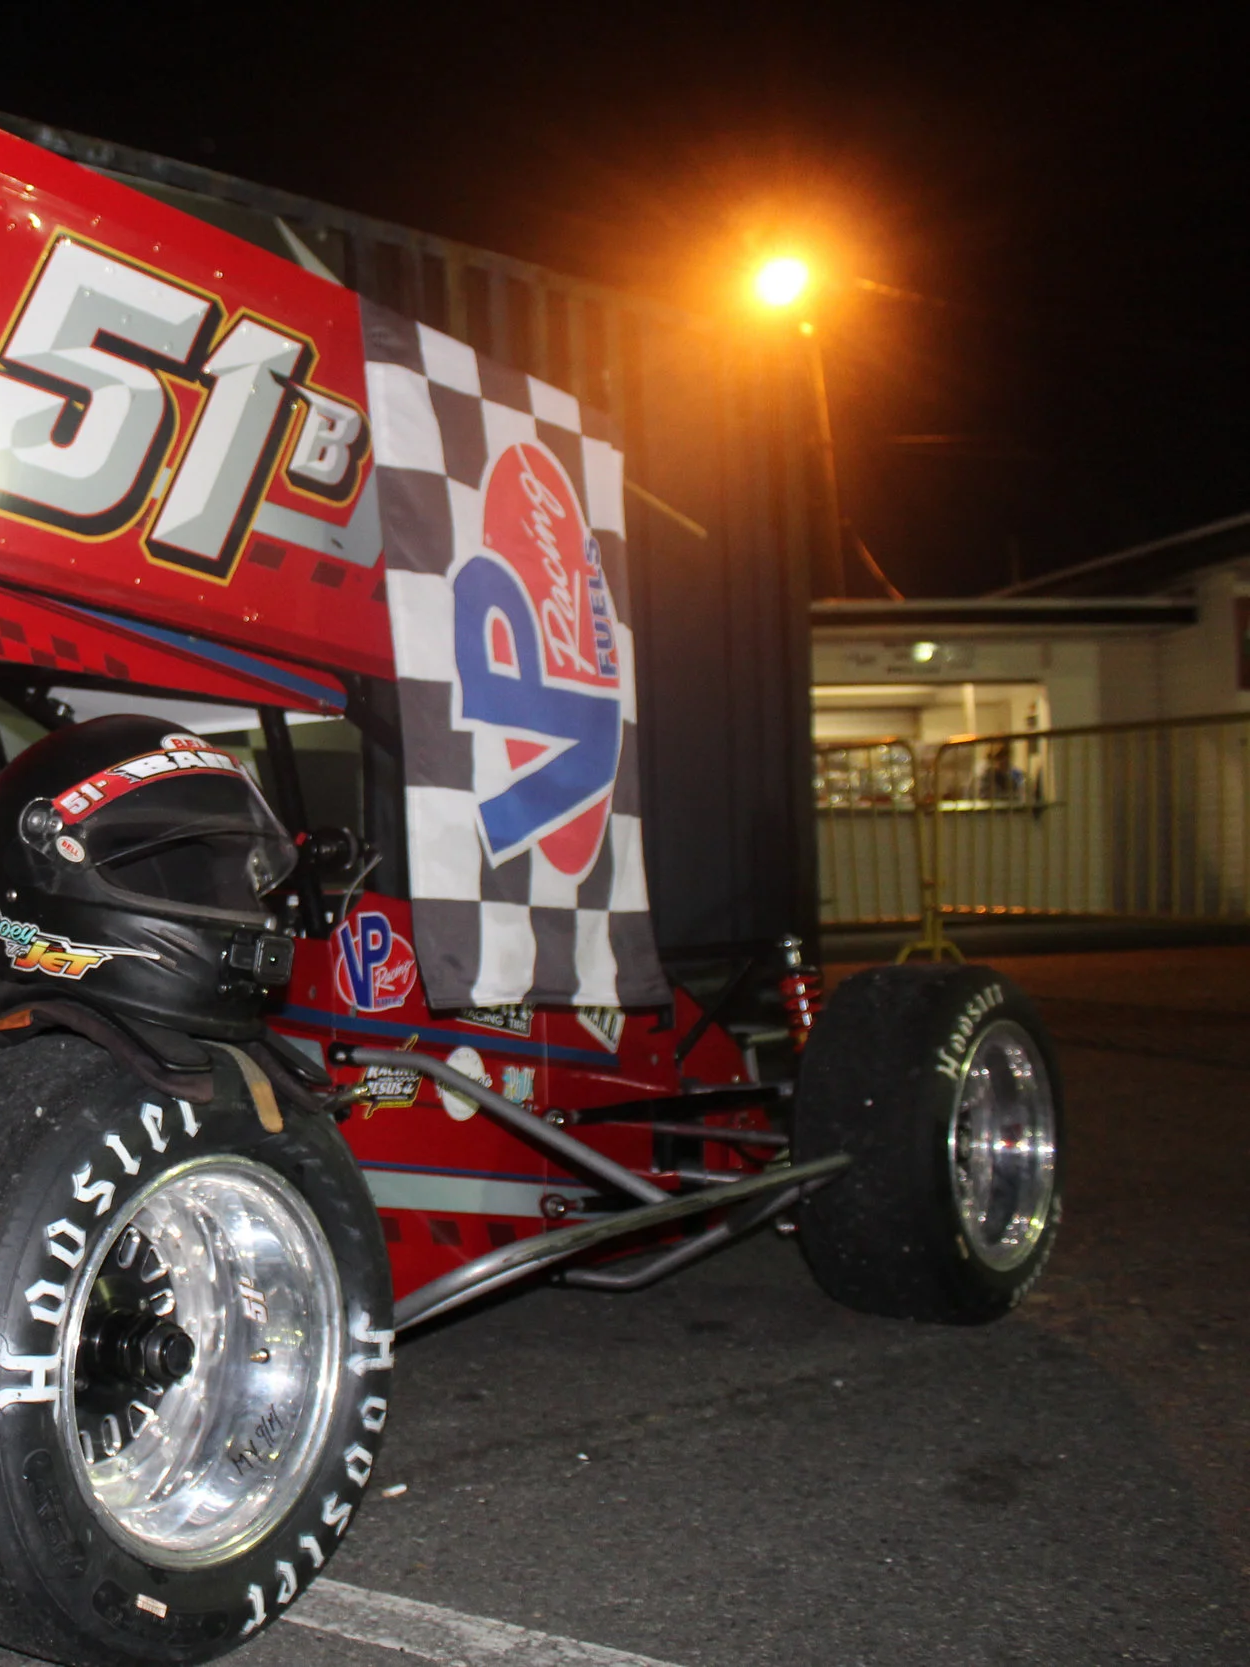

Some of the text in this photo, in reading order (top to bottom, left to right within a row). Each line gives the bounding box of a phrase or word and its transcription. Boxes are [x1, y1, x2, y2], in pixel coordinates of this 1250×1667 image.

[516, 444, 596, 676] Racing
[584, 536, 618, 679] FUELS
[61, 840, 79, 858] BELL
[339, 912, 392, 1009] VP
[375, 960, 414, 996] Racing
